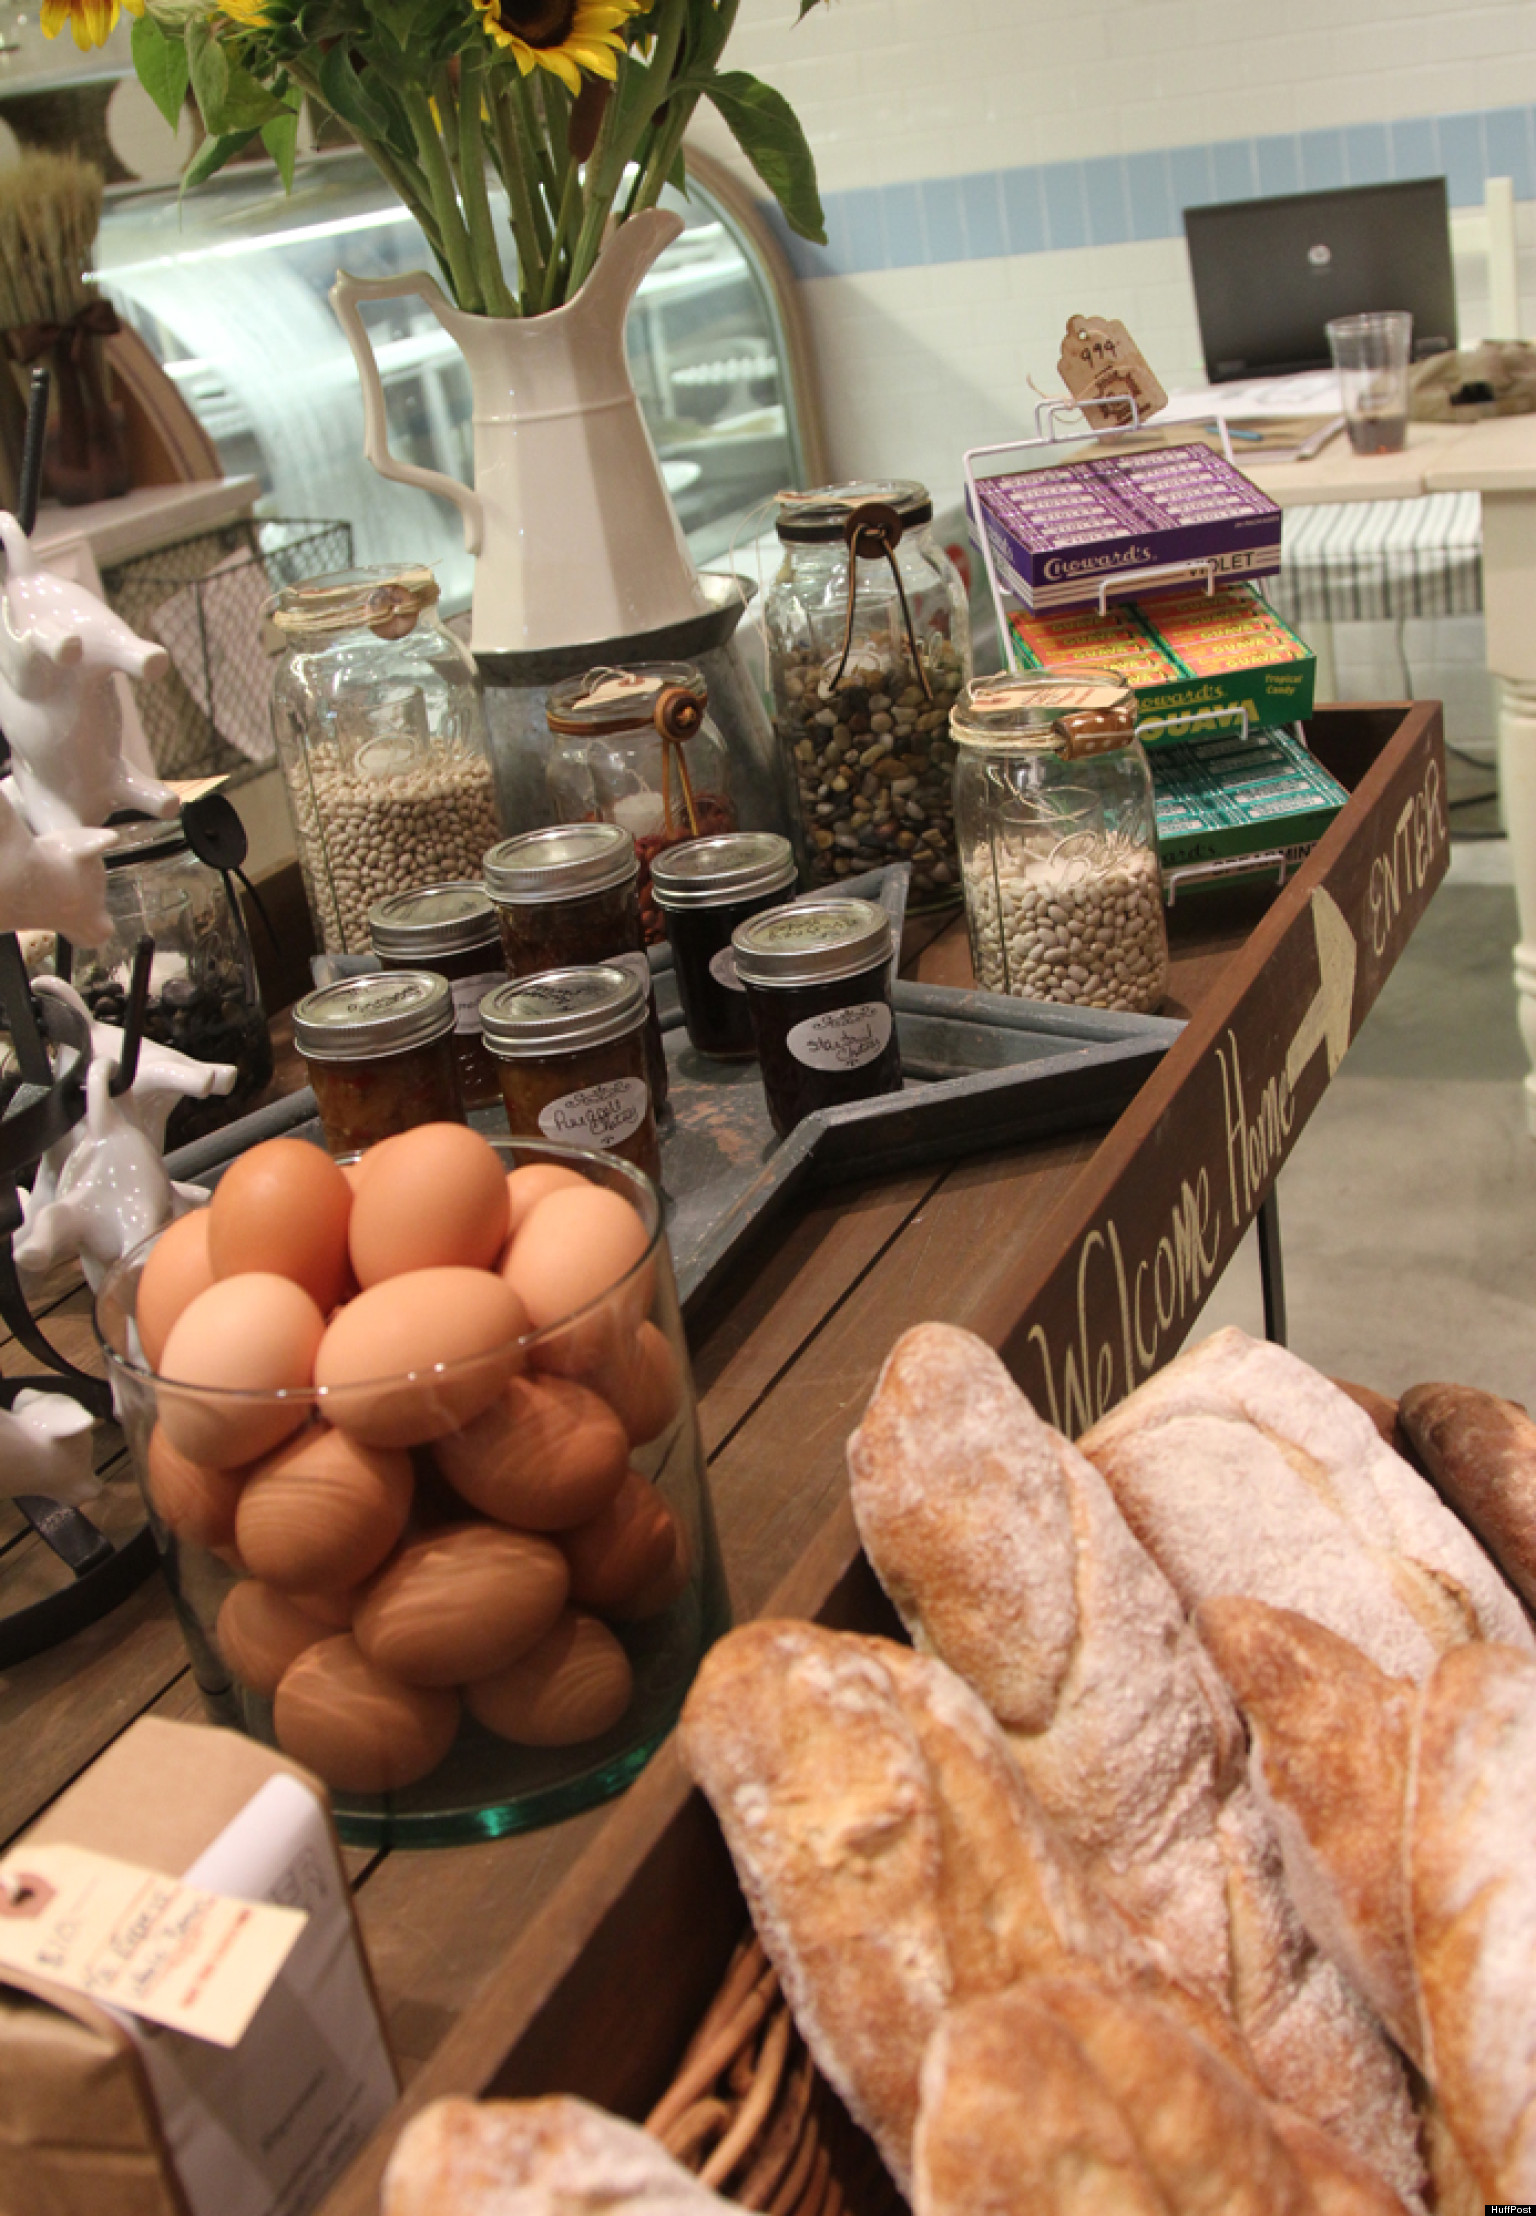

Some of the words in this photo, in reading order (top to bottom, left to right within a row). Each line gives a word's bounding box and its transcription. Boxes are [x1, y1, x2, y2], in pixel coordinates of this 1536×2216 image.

[1138, 698, 1260, 741] GUAVA
[1370, 758, 1446, 958] ENTER
[1028, 1164, 1220, 1442] Welcome
[1214, 1028, 1296, 1226] Home
